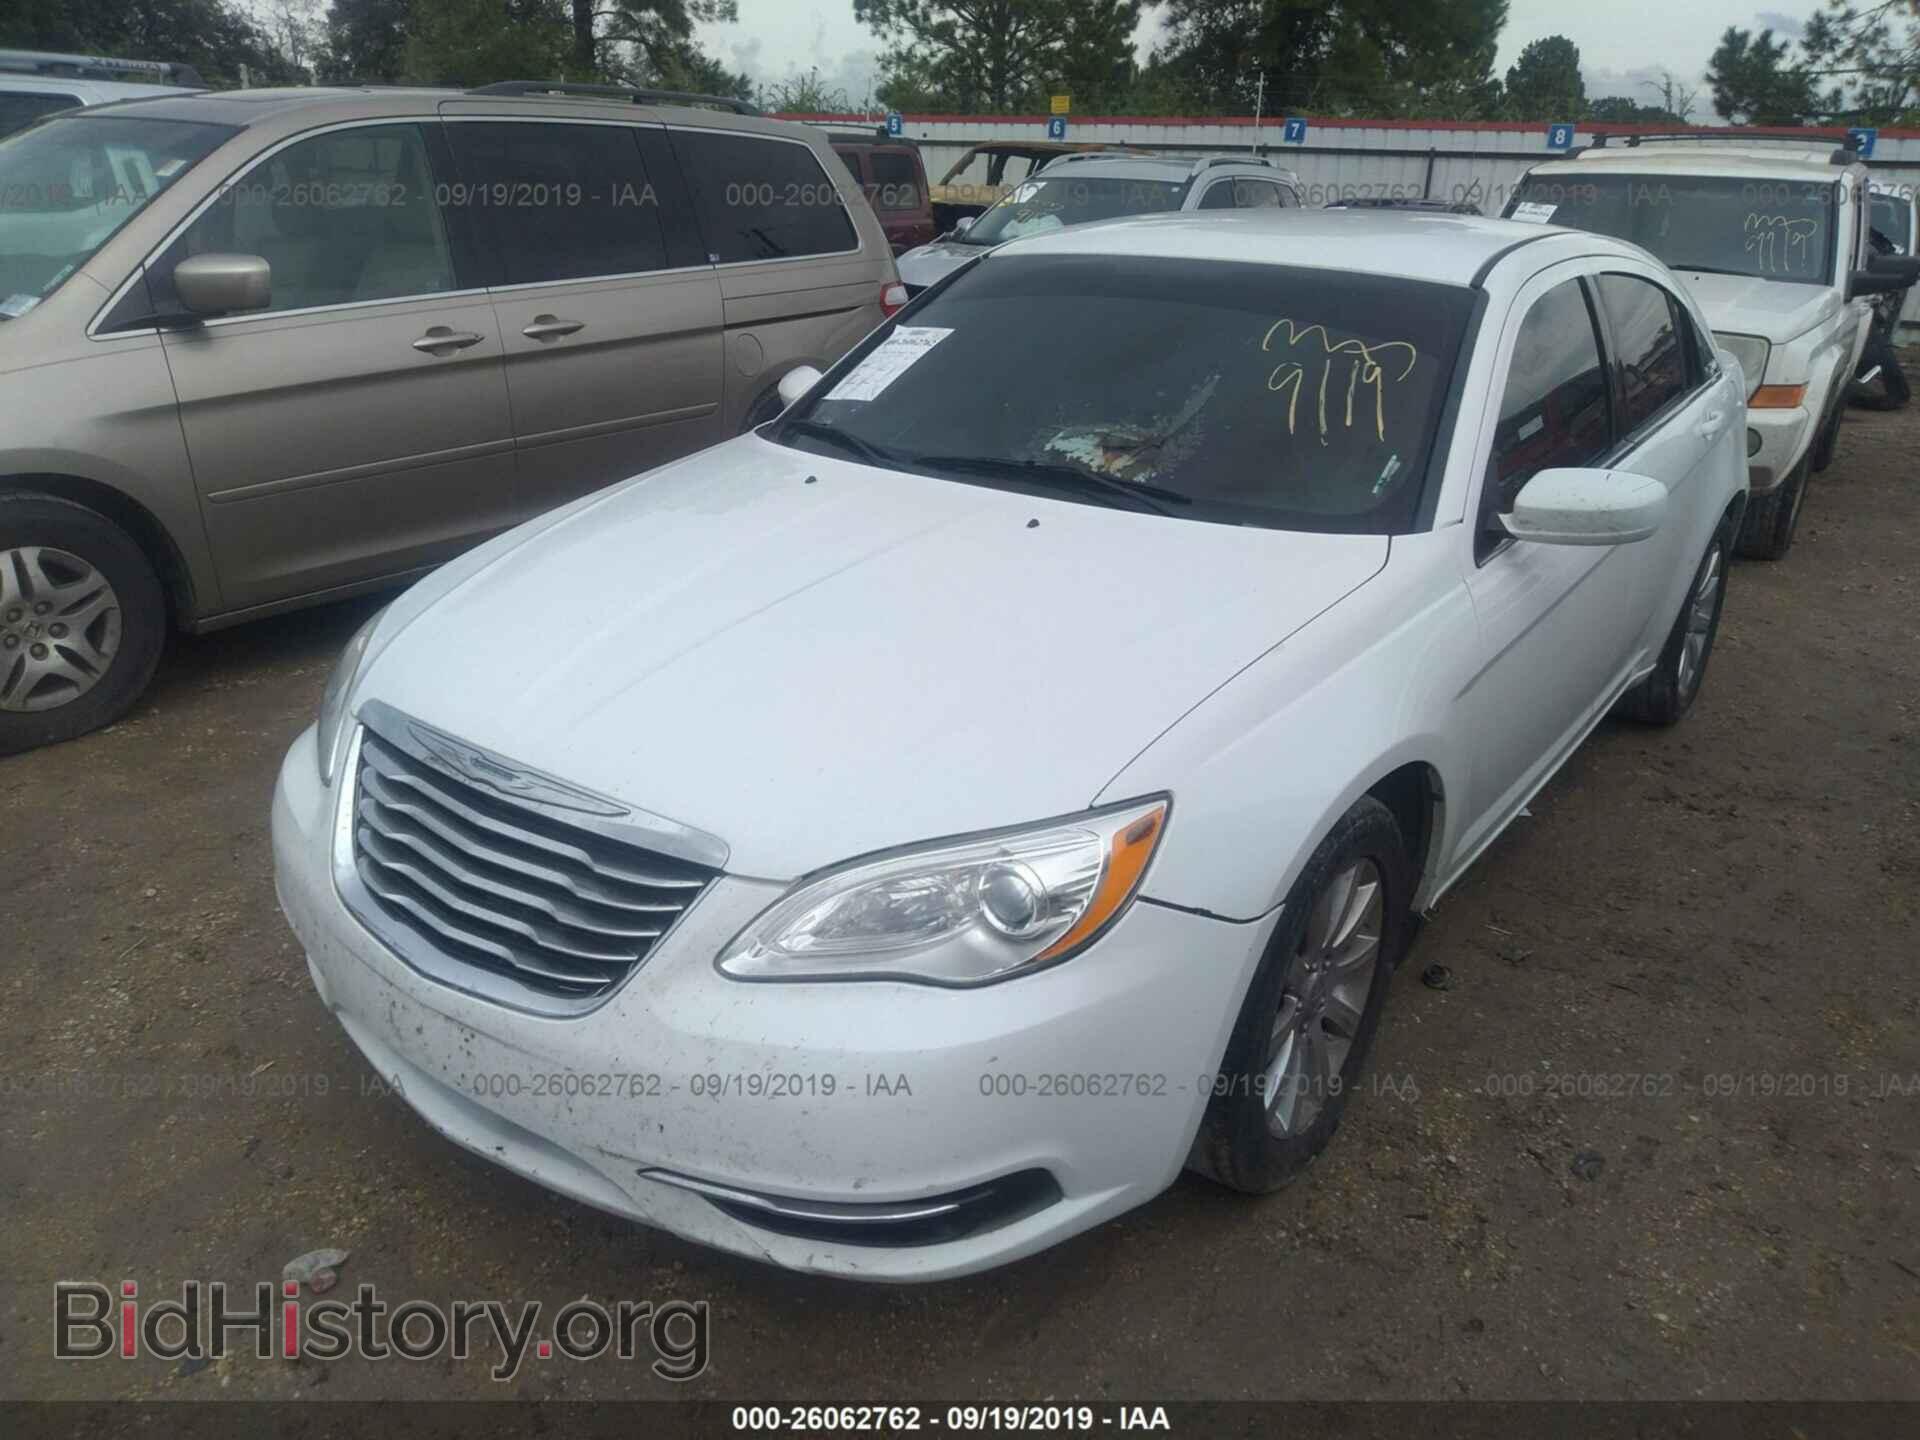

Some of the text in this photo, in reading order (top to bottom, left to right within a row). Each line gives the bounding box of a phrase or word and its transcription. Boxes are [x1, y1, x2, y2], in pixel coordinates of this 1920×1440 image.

[891, 118, 898, 131] 5
[1053, 120, 1061, 135] 6
[1291, 123, 1300, 138] 7
[1555, 129, 1566, 145] 8
[1268, 361, 1385, 446] 9119
